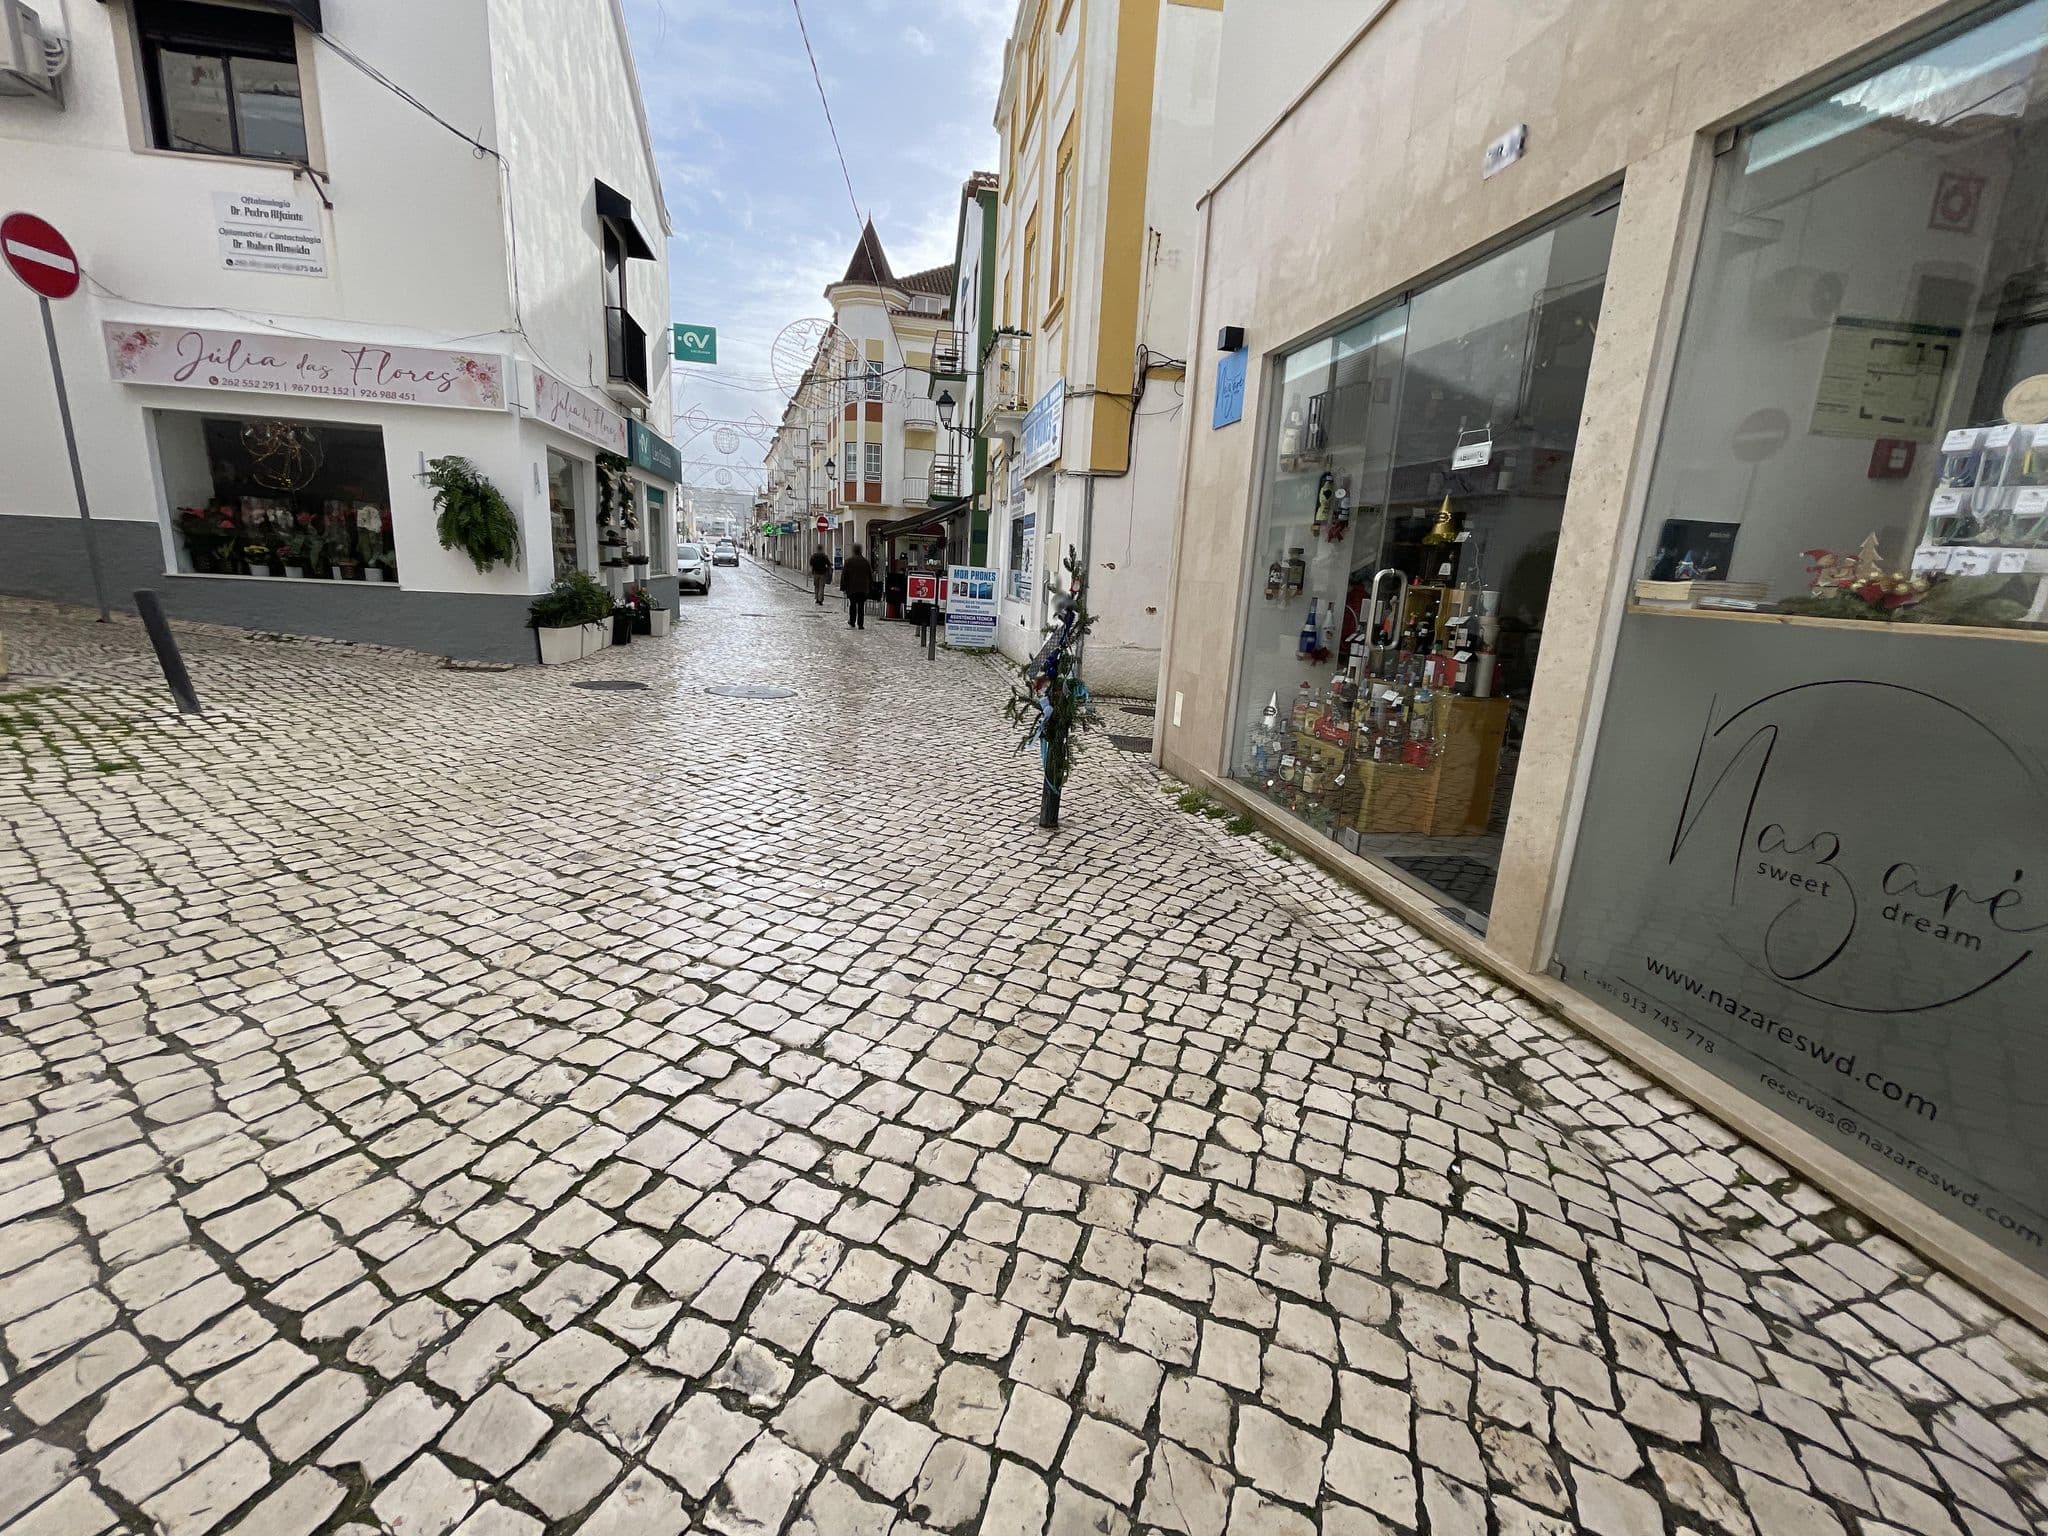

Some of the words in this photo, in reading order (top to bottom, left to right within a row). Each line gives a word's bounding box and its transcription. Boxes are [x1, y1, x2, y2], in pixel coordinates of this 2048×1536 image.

[244, 207, 270, 218] Pedro
[270, 209, 304, 222] Alfaiate
[174, 331, 287, 382] Júlia
[296, 353, 333, 380] das
[341, 345, 460, 392] Flores
[221, 377, 240, 387] 262
[241, 379, 261, 389] 552
[262, 380, 280, 391] 291
[291, 383, 310, 393] 967
[310, 384, 330, 394] 012
[331, 386, 349, 397] 152
[359, 388, 378, 399] 926
[379, 390, 398, 400] 988
[399, 391, 416, 402] 451
[970, 570, 996, 582] PHONES
[1756, 860, 1832, 898] sweet
[1882, 902, 1982, 952] dream
[1621, 991, 1648, 1015] 913
[1653, 1007, 1680, 1034] 745
[1685, 1027, 1715, 1054] 778
[1646, 955, 1938, 1121] www.nazareswd.com
[1760, 1072, 2044, 1248] reservas@nazareswd.com
